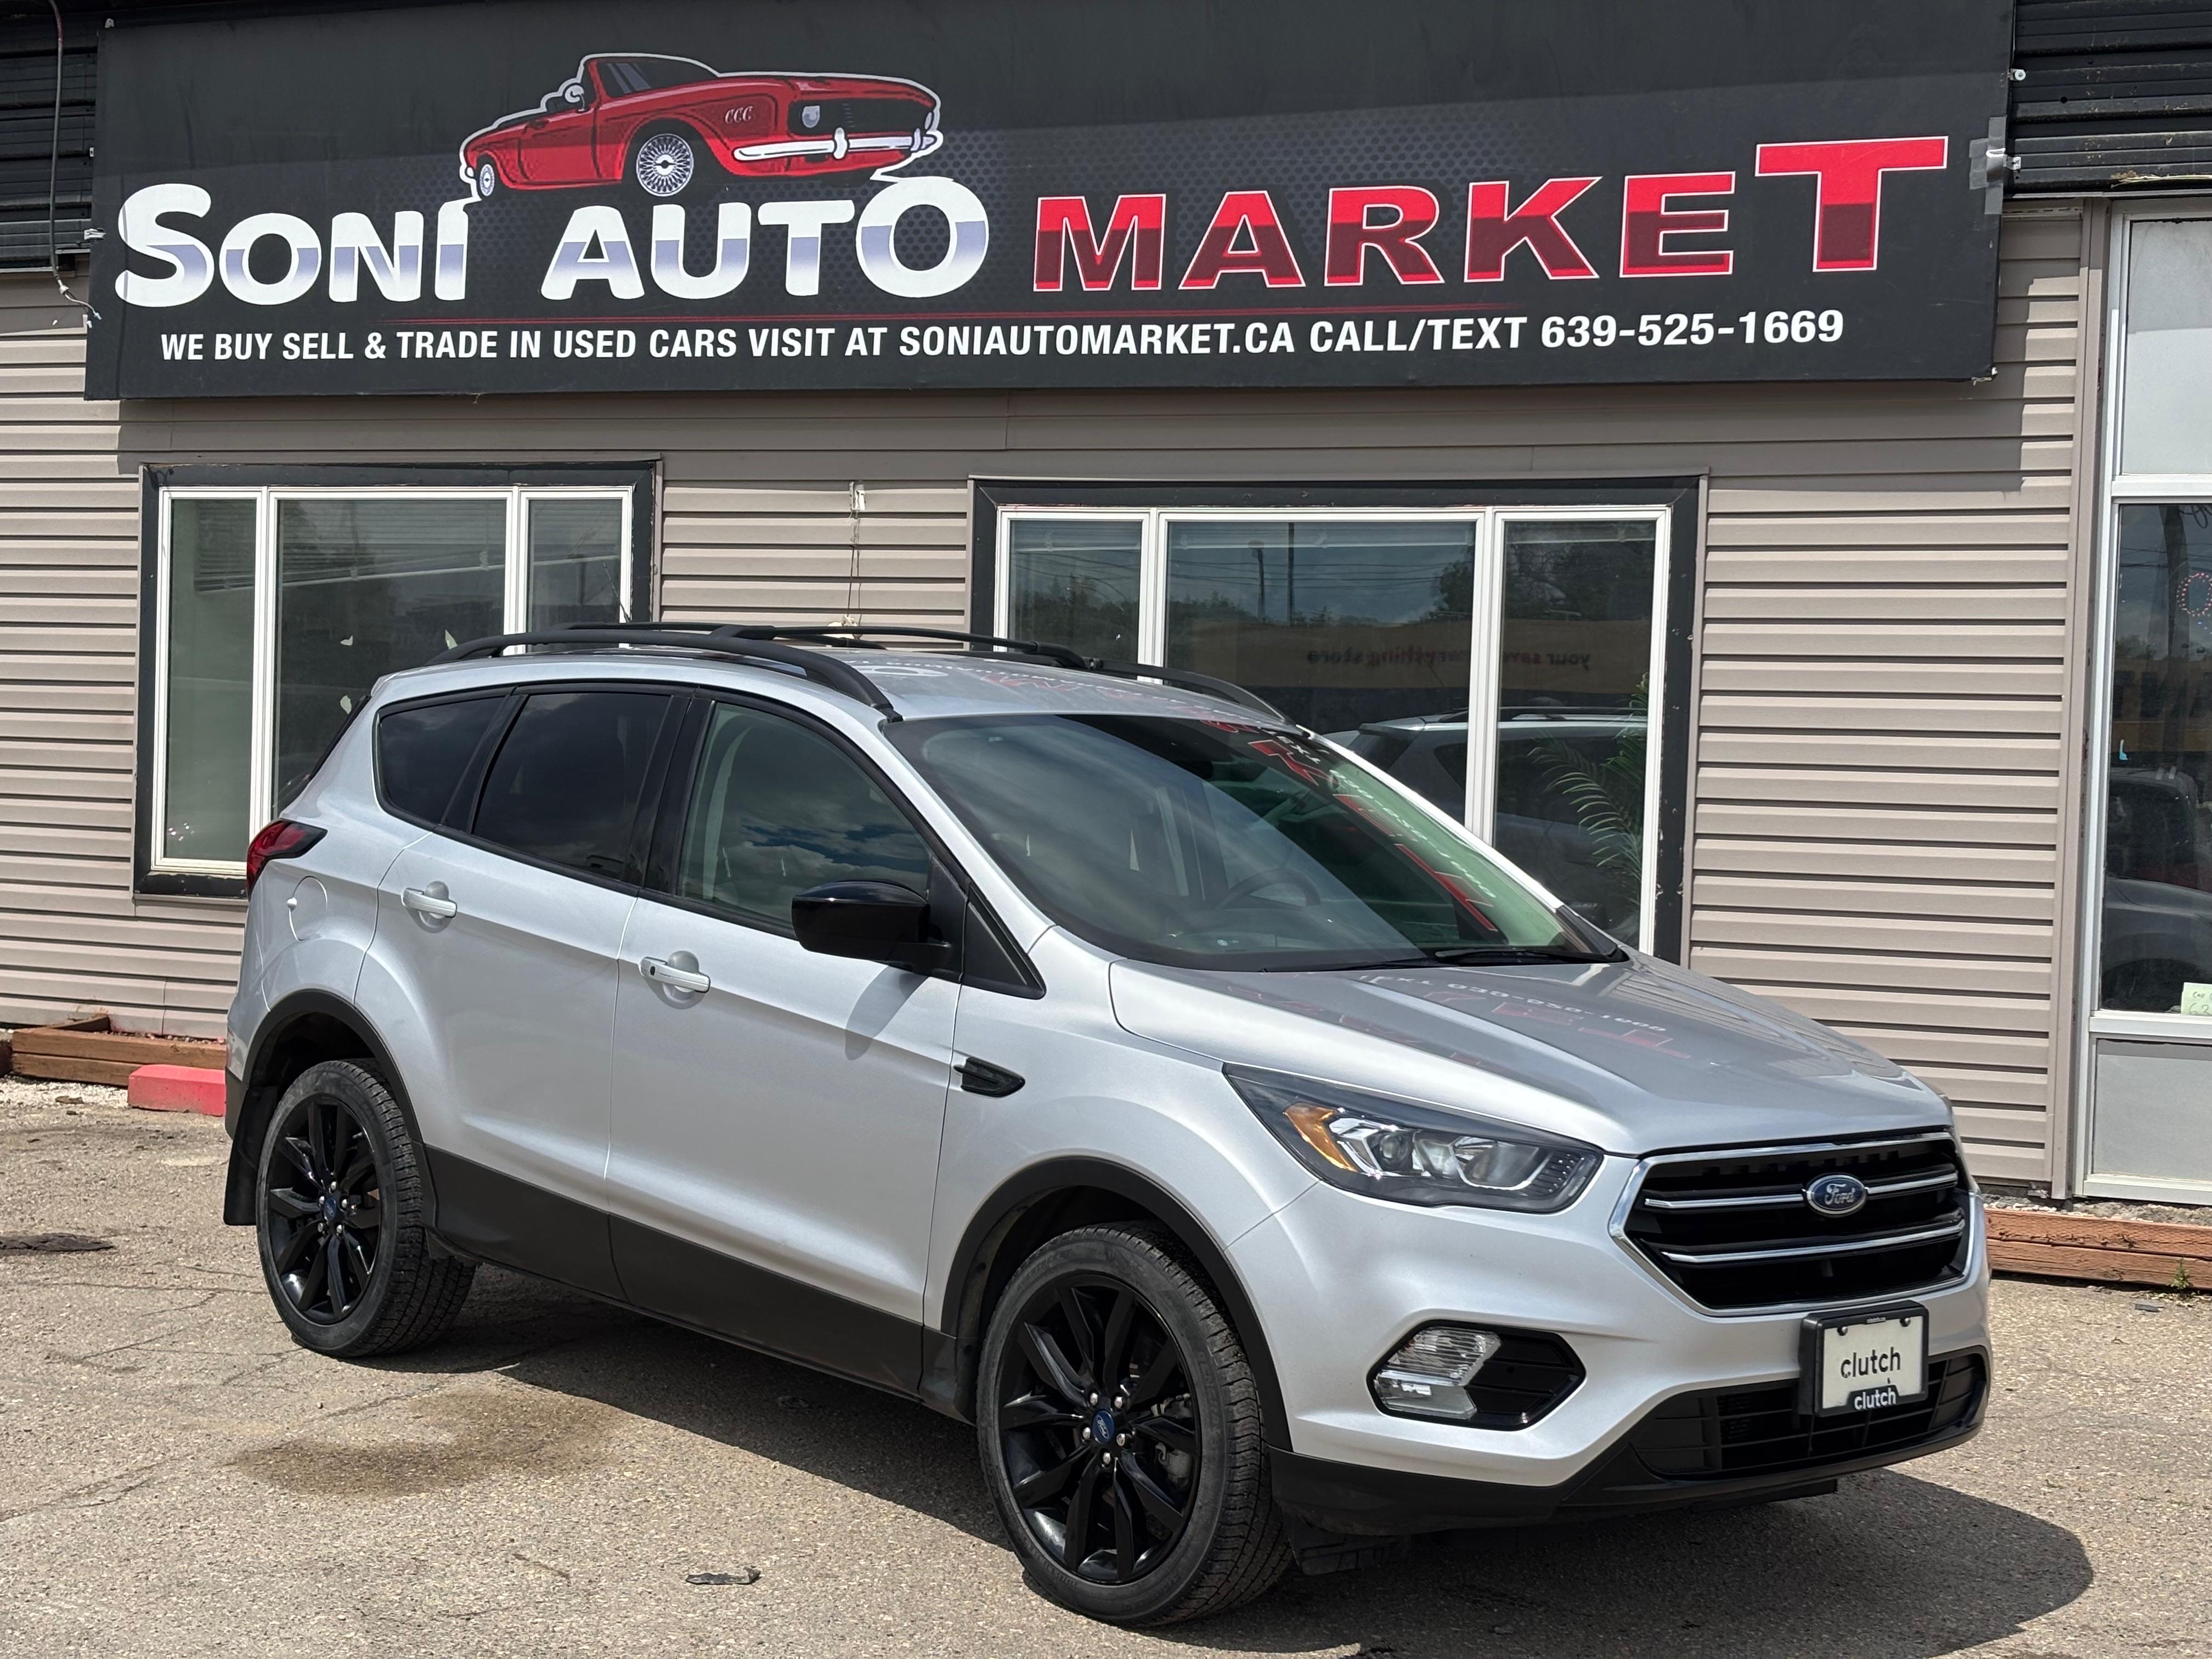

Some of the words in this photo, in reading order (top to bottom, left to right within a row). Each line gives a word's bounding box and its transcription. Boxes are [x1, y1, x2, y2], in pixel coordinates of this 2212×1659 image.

[115, 184, 470, 307] SONI
[540, 178, 990, 300] AUTO
[1033, 136, 1949, 292] MARKET
[161, 334, 204, 360] WE
[215, 334, 273, 360] BUY
[283, 332, 354, 360] SELL
[365, 332, 386, 359] &
[396, 331, 498, 359] TRADE
[510, 330, 541, 358] IN
[554, 330, 636, 358] USED
[650, 329, 737, 358] CARS
[748, 328, 836, 357] VISIT
[845, 327, 888, 356] AT
[899, 322, 1295, 356] SONIAUTOMARKET.CA
[1310, 317, 1528, 353] CALL/TEXT
[1541, 309, 1843, 348] 639-525-1669
[1825, 1183, 1855, 1205] Ford
[1841, 1346, 1901, 1379] clutch
[1854, 1387, 1897, 1410] clutch
